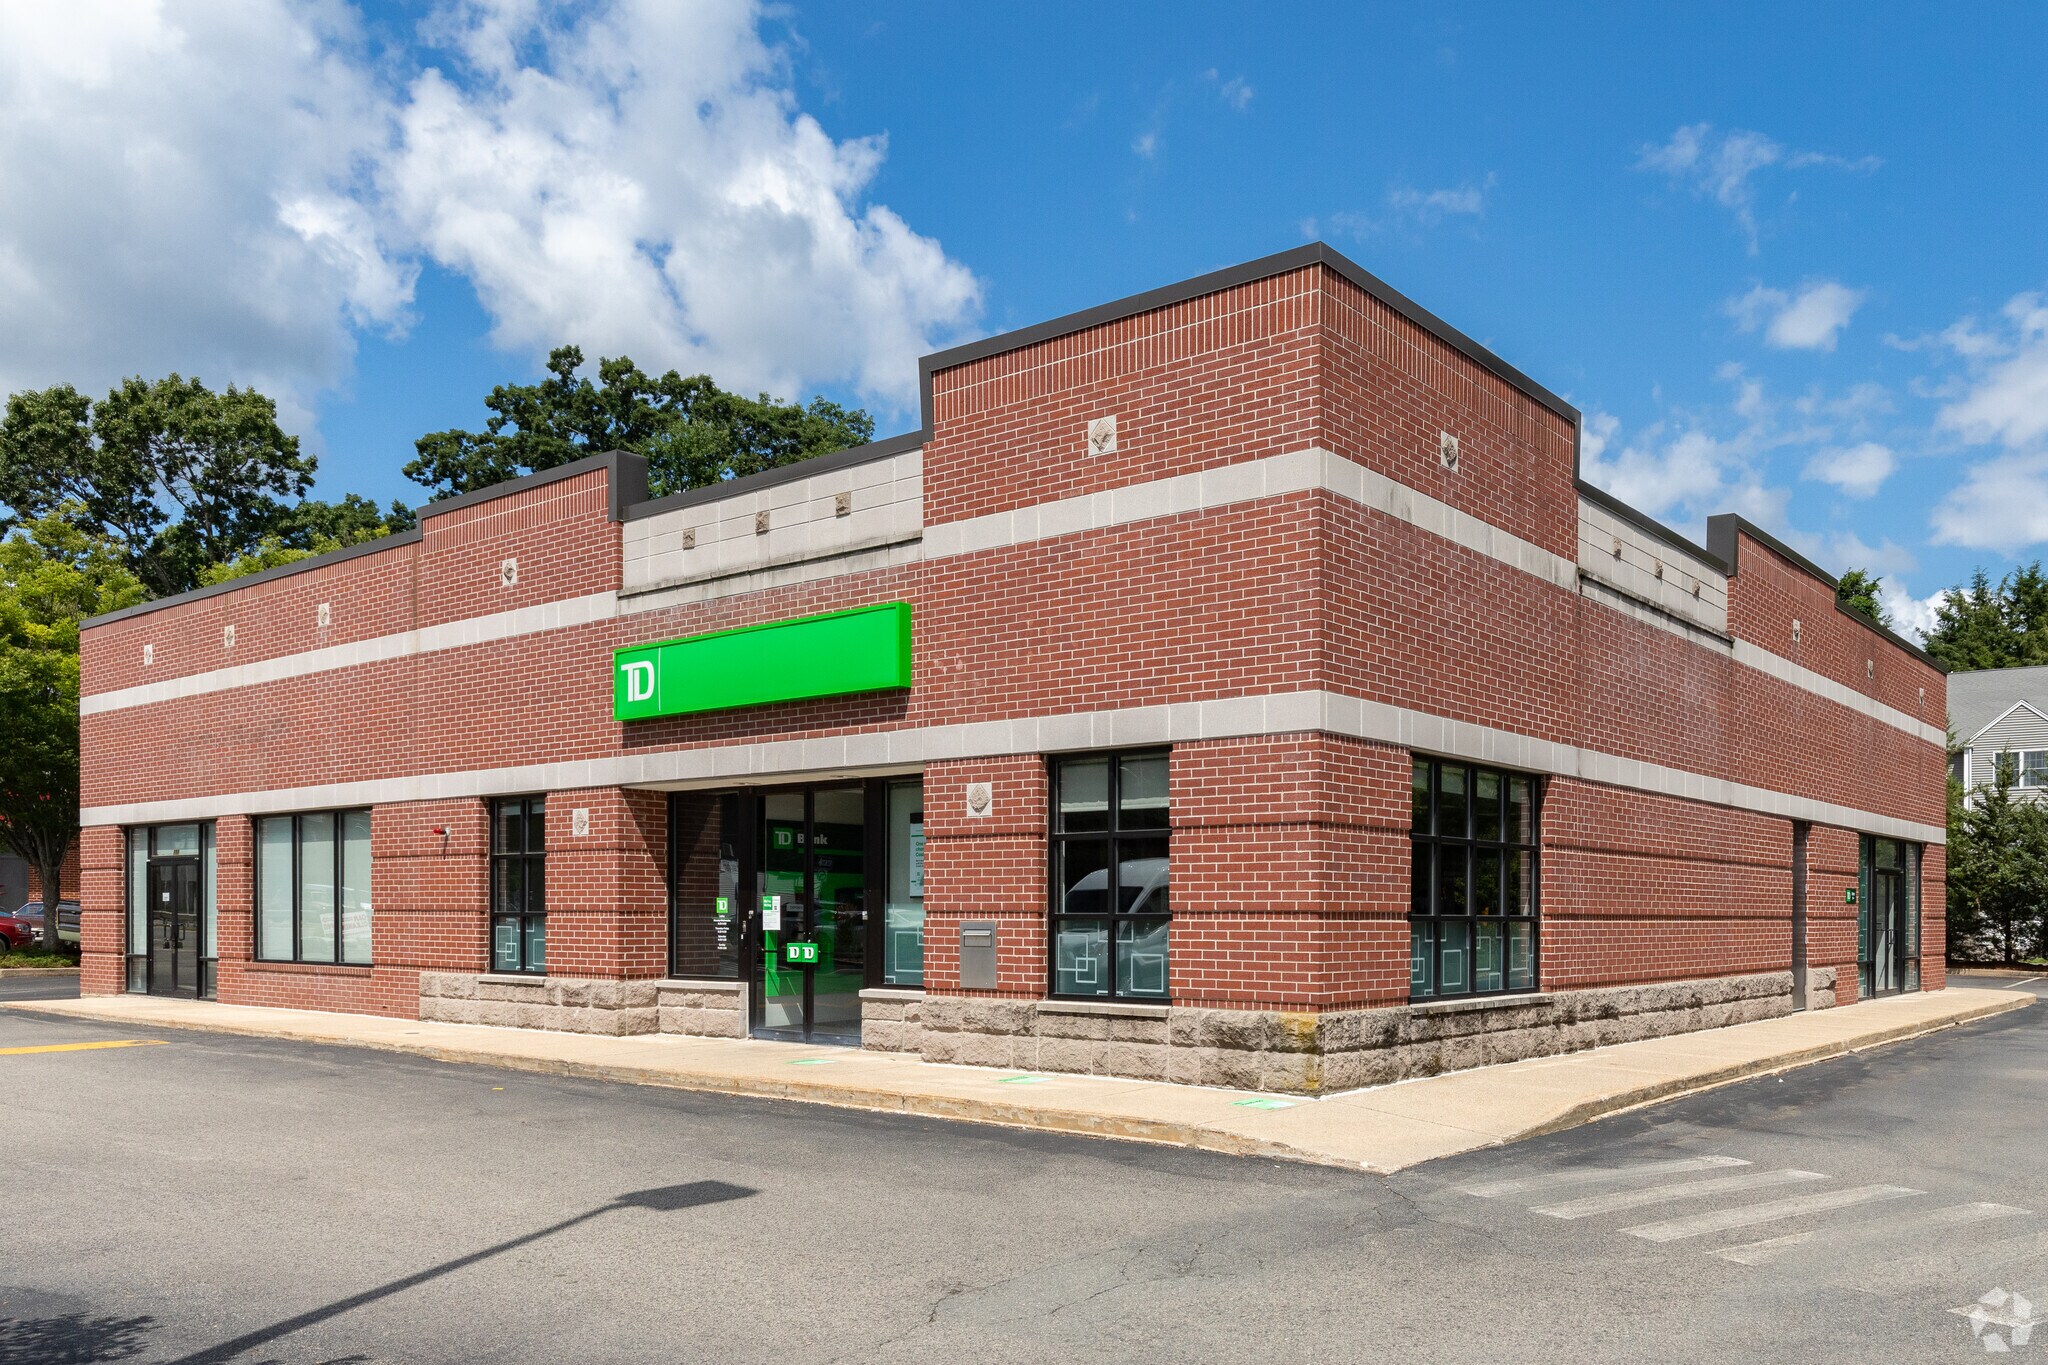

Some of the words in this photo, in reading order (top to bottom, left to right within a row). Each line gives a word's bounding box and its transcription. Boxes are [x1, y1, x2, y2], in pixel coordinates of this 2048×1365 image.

[621, 660, 655, 702] TD
[775, 831, 792, 845] TD
[797, 833, 828, 845] Bnk
[717, 900, 727, 910] TD
[788, 946, 800, 958] TD
[802, 946, 814, 959] TD
